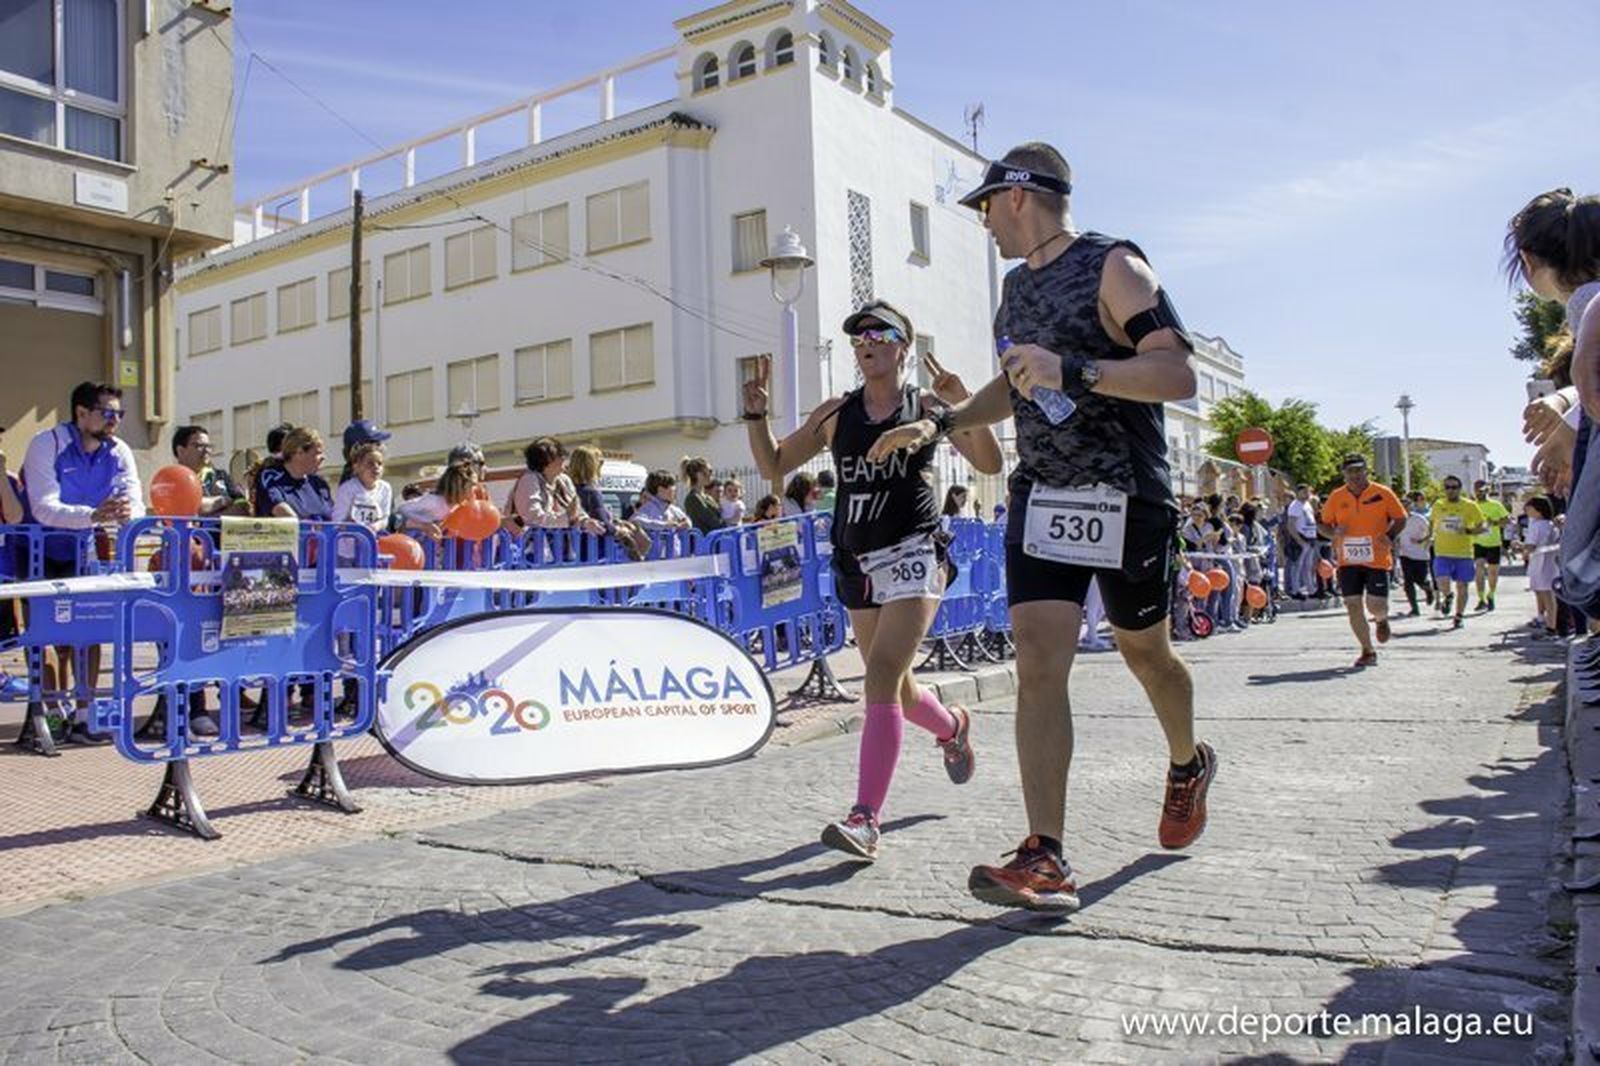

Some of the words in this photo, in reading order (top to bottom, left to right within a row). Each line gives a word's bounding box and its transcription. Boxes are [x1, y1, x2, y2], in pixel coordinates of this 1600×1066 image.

[841, 454, 909, 482] EARN
[1048, 514, 1104, 544] 530
[559, 658, 753, 706] MÁLAGA
[403, 681, 551, 736] 2020
[562, 705, 642, 723] EUROPEAN
[644, 704, 698, 718] CAPITAL
[700, 703, 717, 716] OF
[720, 702, 758, 717] SPORT
